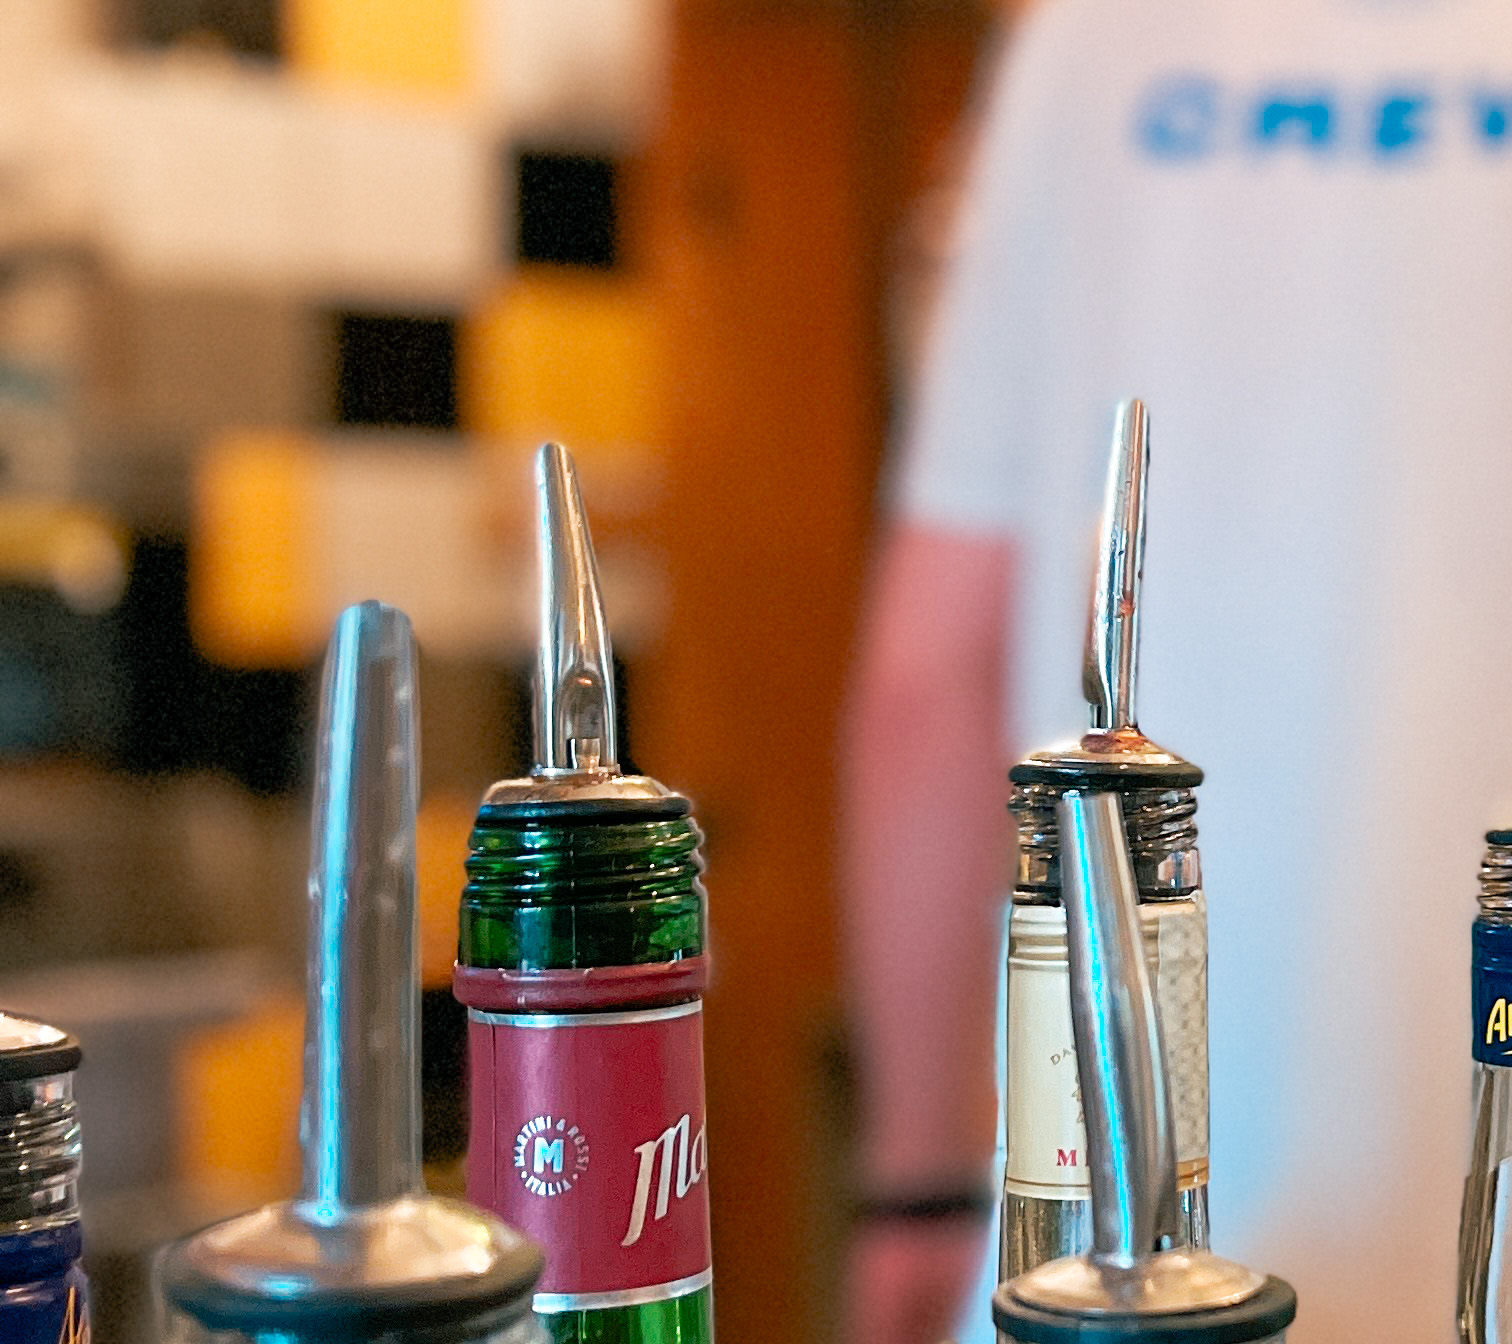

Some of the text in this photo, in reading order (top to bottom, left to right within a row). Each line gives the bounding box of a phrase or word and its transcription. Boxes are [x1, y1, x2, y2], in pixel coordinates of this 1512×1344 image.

[513, 1115, 552, 1168] MARTINI
[567, 1125, 590, 1171] ROSSI
[533, 1136, 564, 1174] M
[524, 1175, 572, 1196] ITALIA
